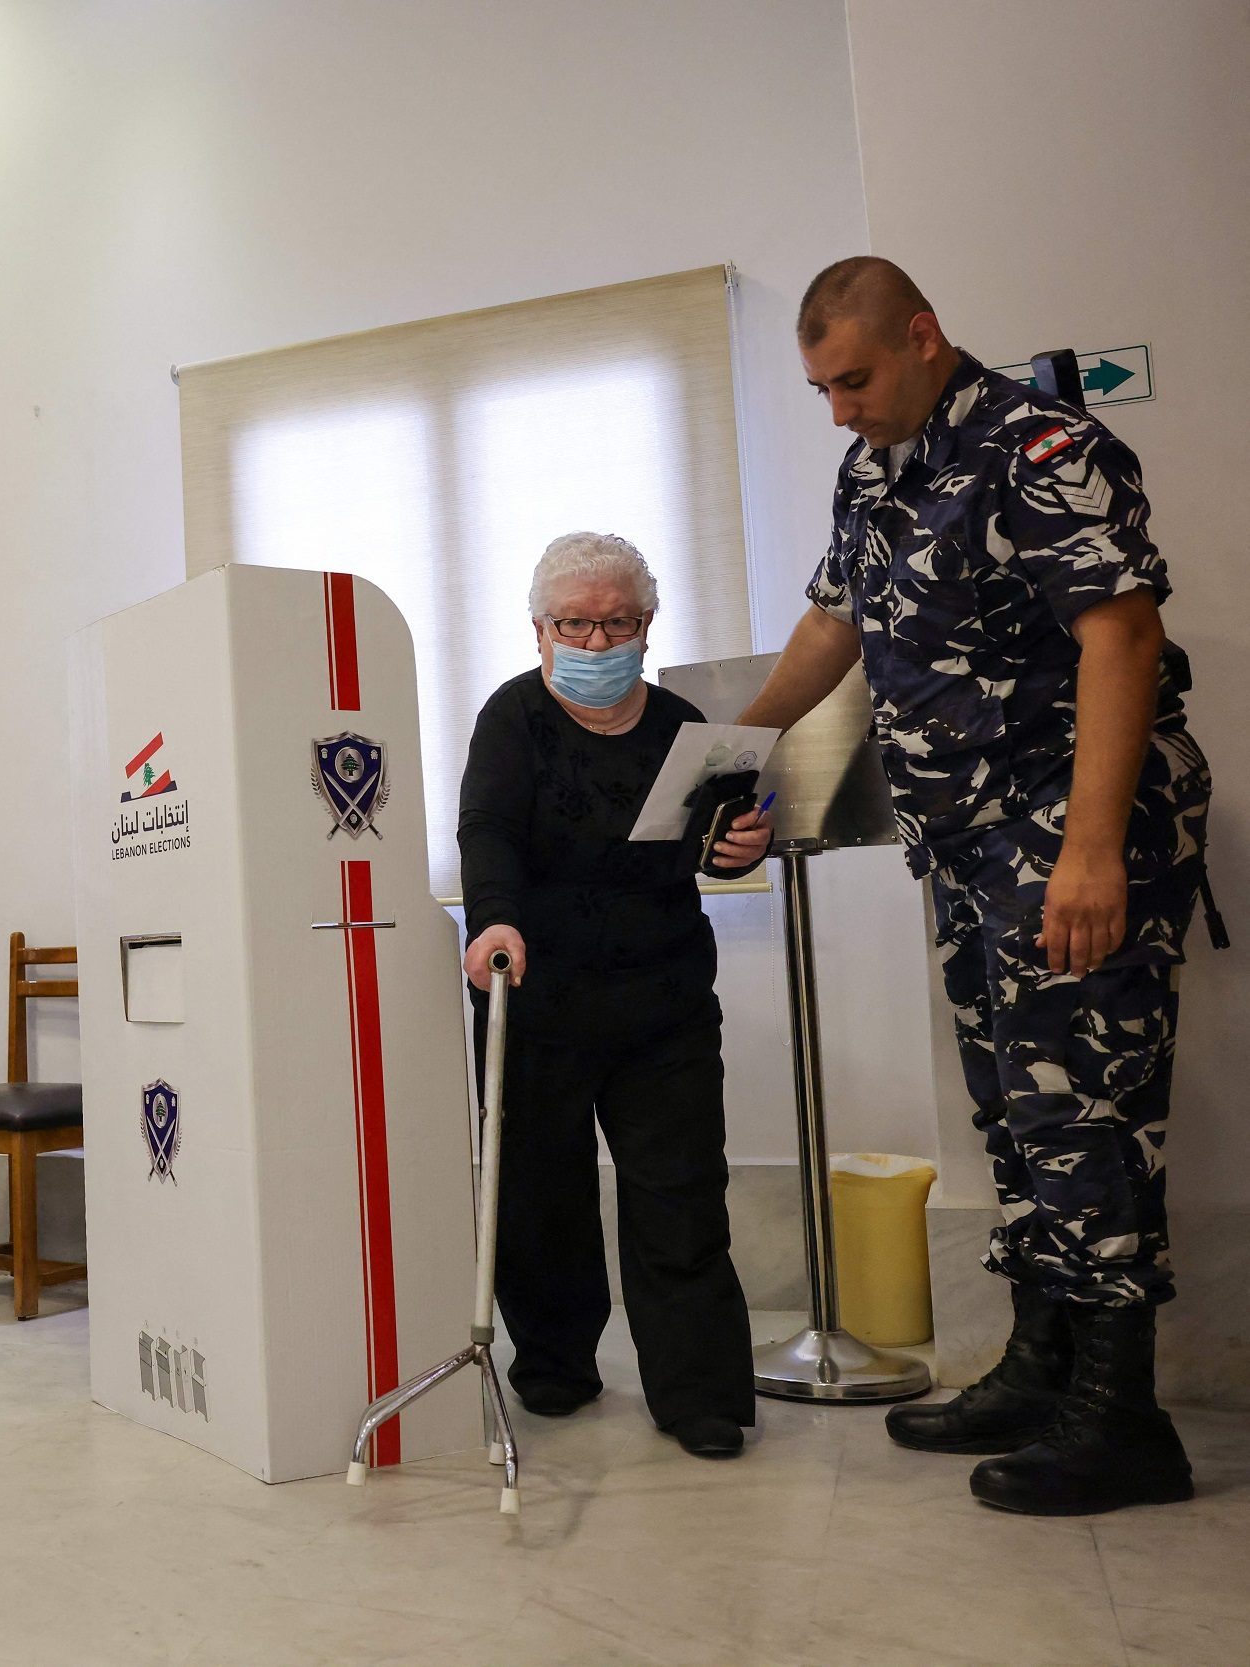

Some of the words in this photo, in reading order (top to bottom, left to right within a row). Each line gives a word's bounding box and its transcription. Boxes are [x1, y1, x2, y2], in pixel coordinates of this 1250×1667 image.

[111, 811, 139, 844] لبنان
[142, 800, 189, 834] إنتخابات
[111, 844, 147, 860] LEBANON
[149, 836, 191, 854] ELECTIONS
